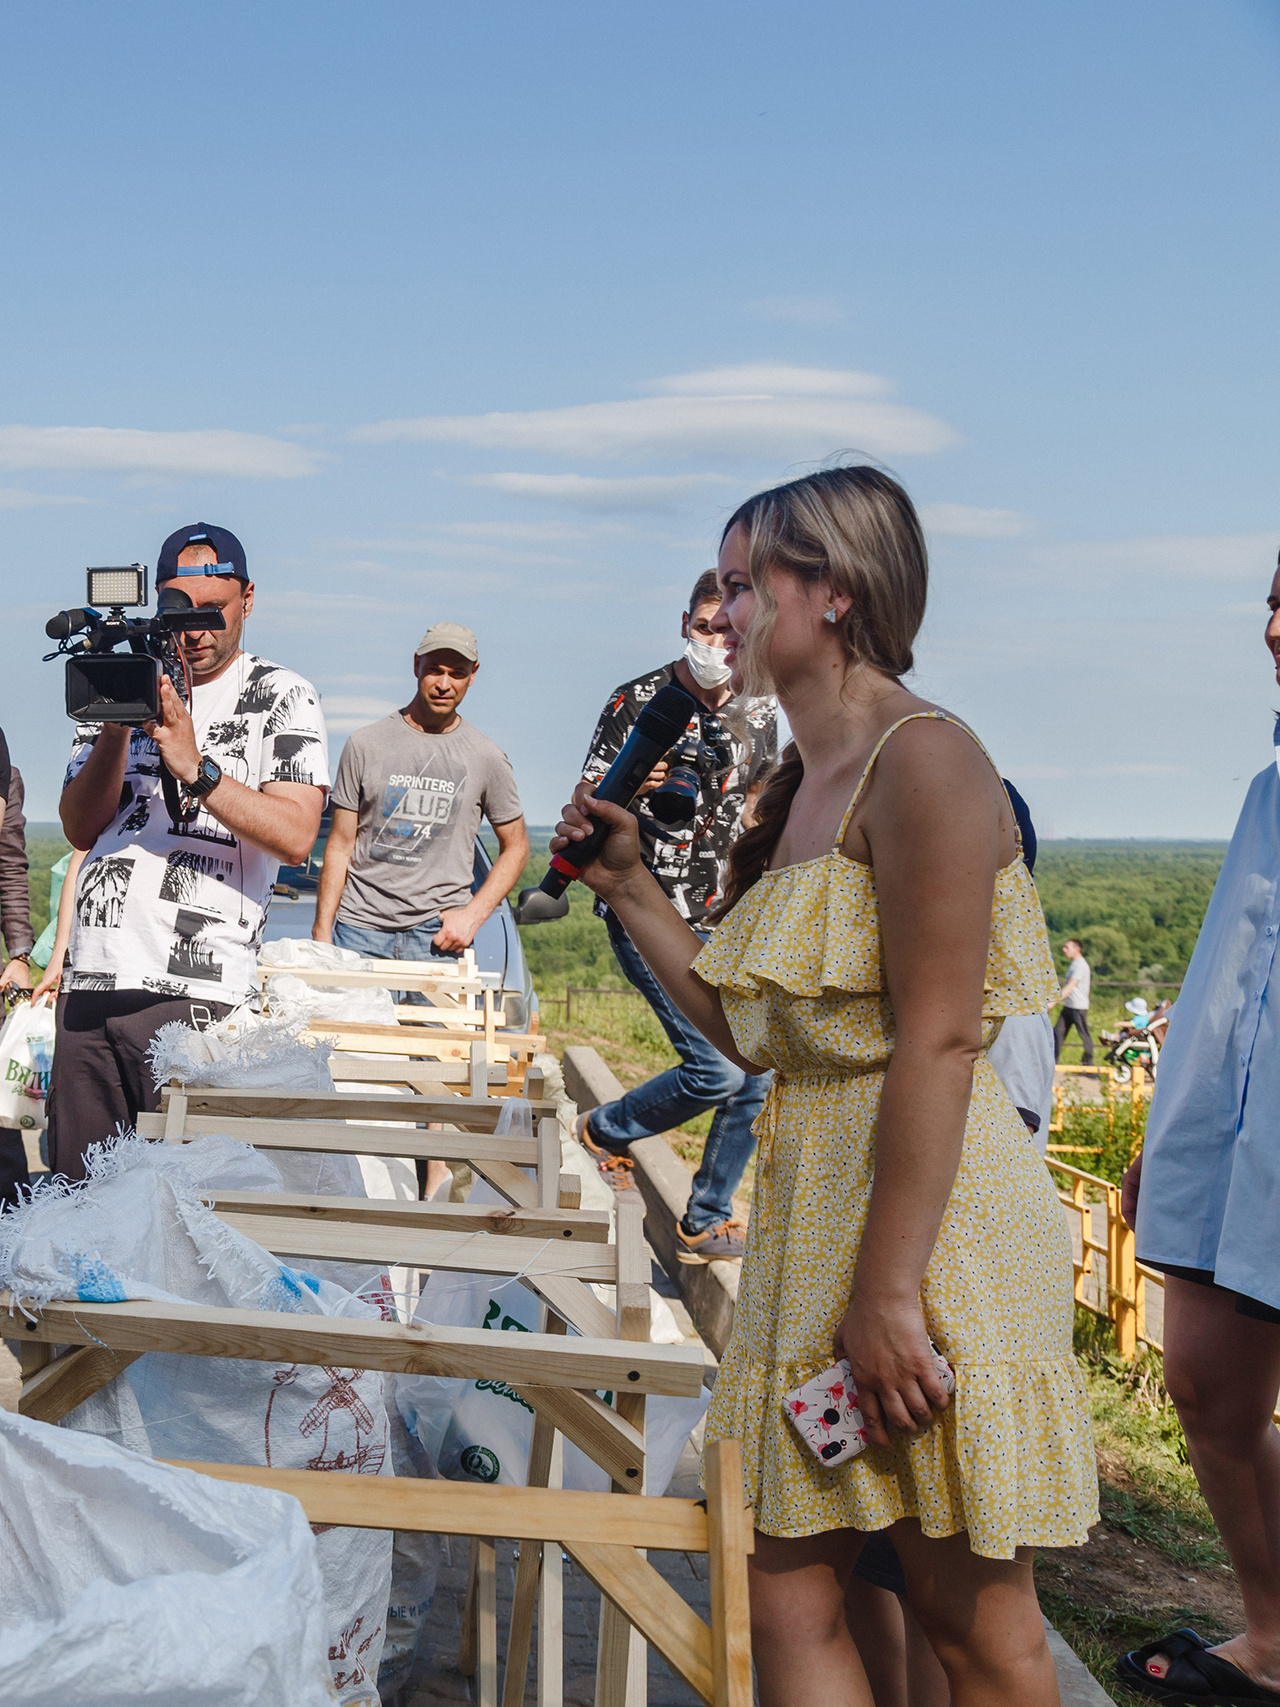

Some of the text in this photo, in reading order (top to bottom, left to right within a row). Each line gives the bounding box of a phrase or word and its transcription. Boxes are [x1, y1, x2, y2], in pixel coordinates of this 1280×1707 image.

[388, 774, 455, 794] SPRINTERS
[387, 790, 451, 819] CLUB
[395, 821, 431, 839] 1974
[387, 1605, 407, 1618] ЫЕ
